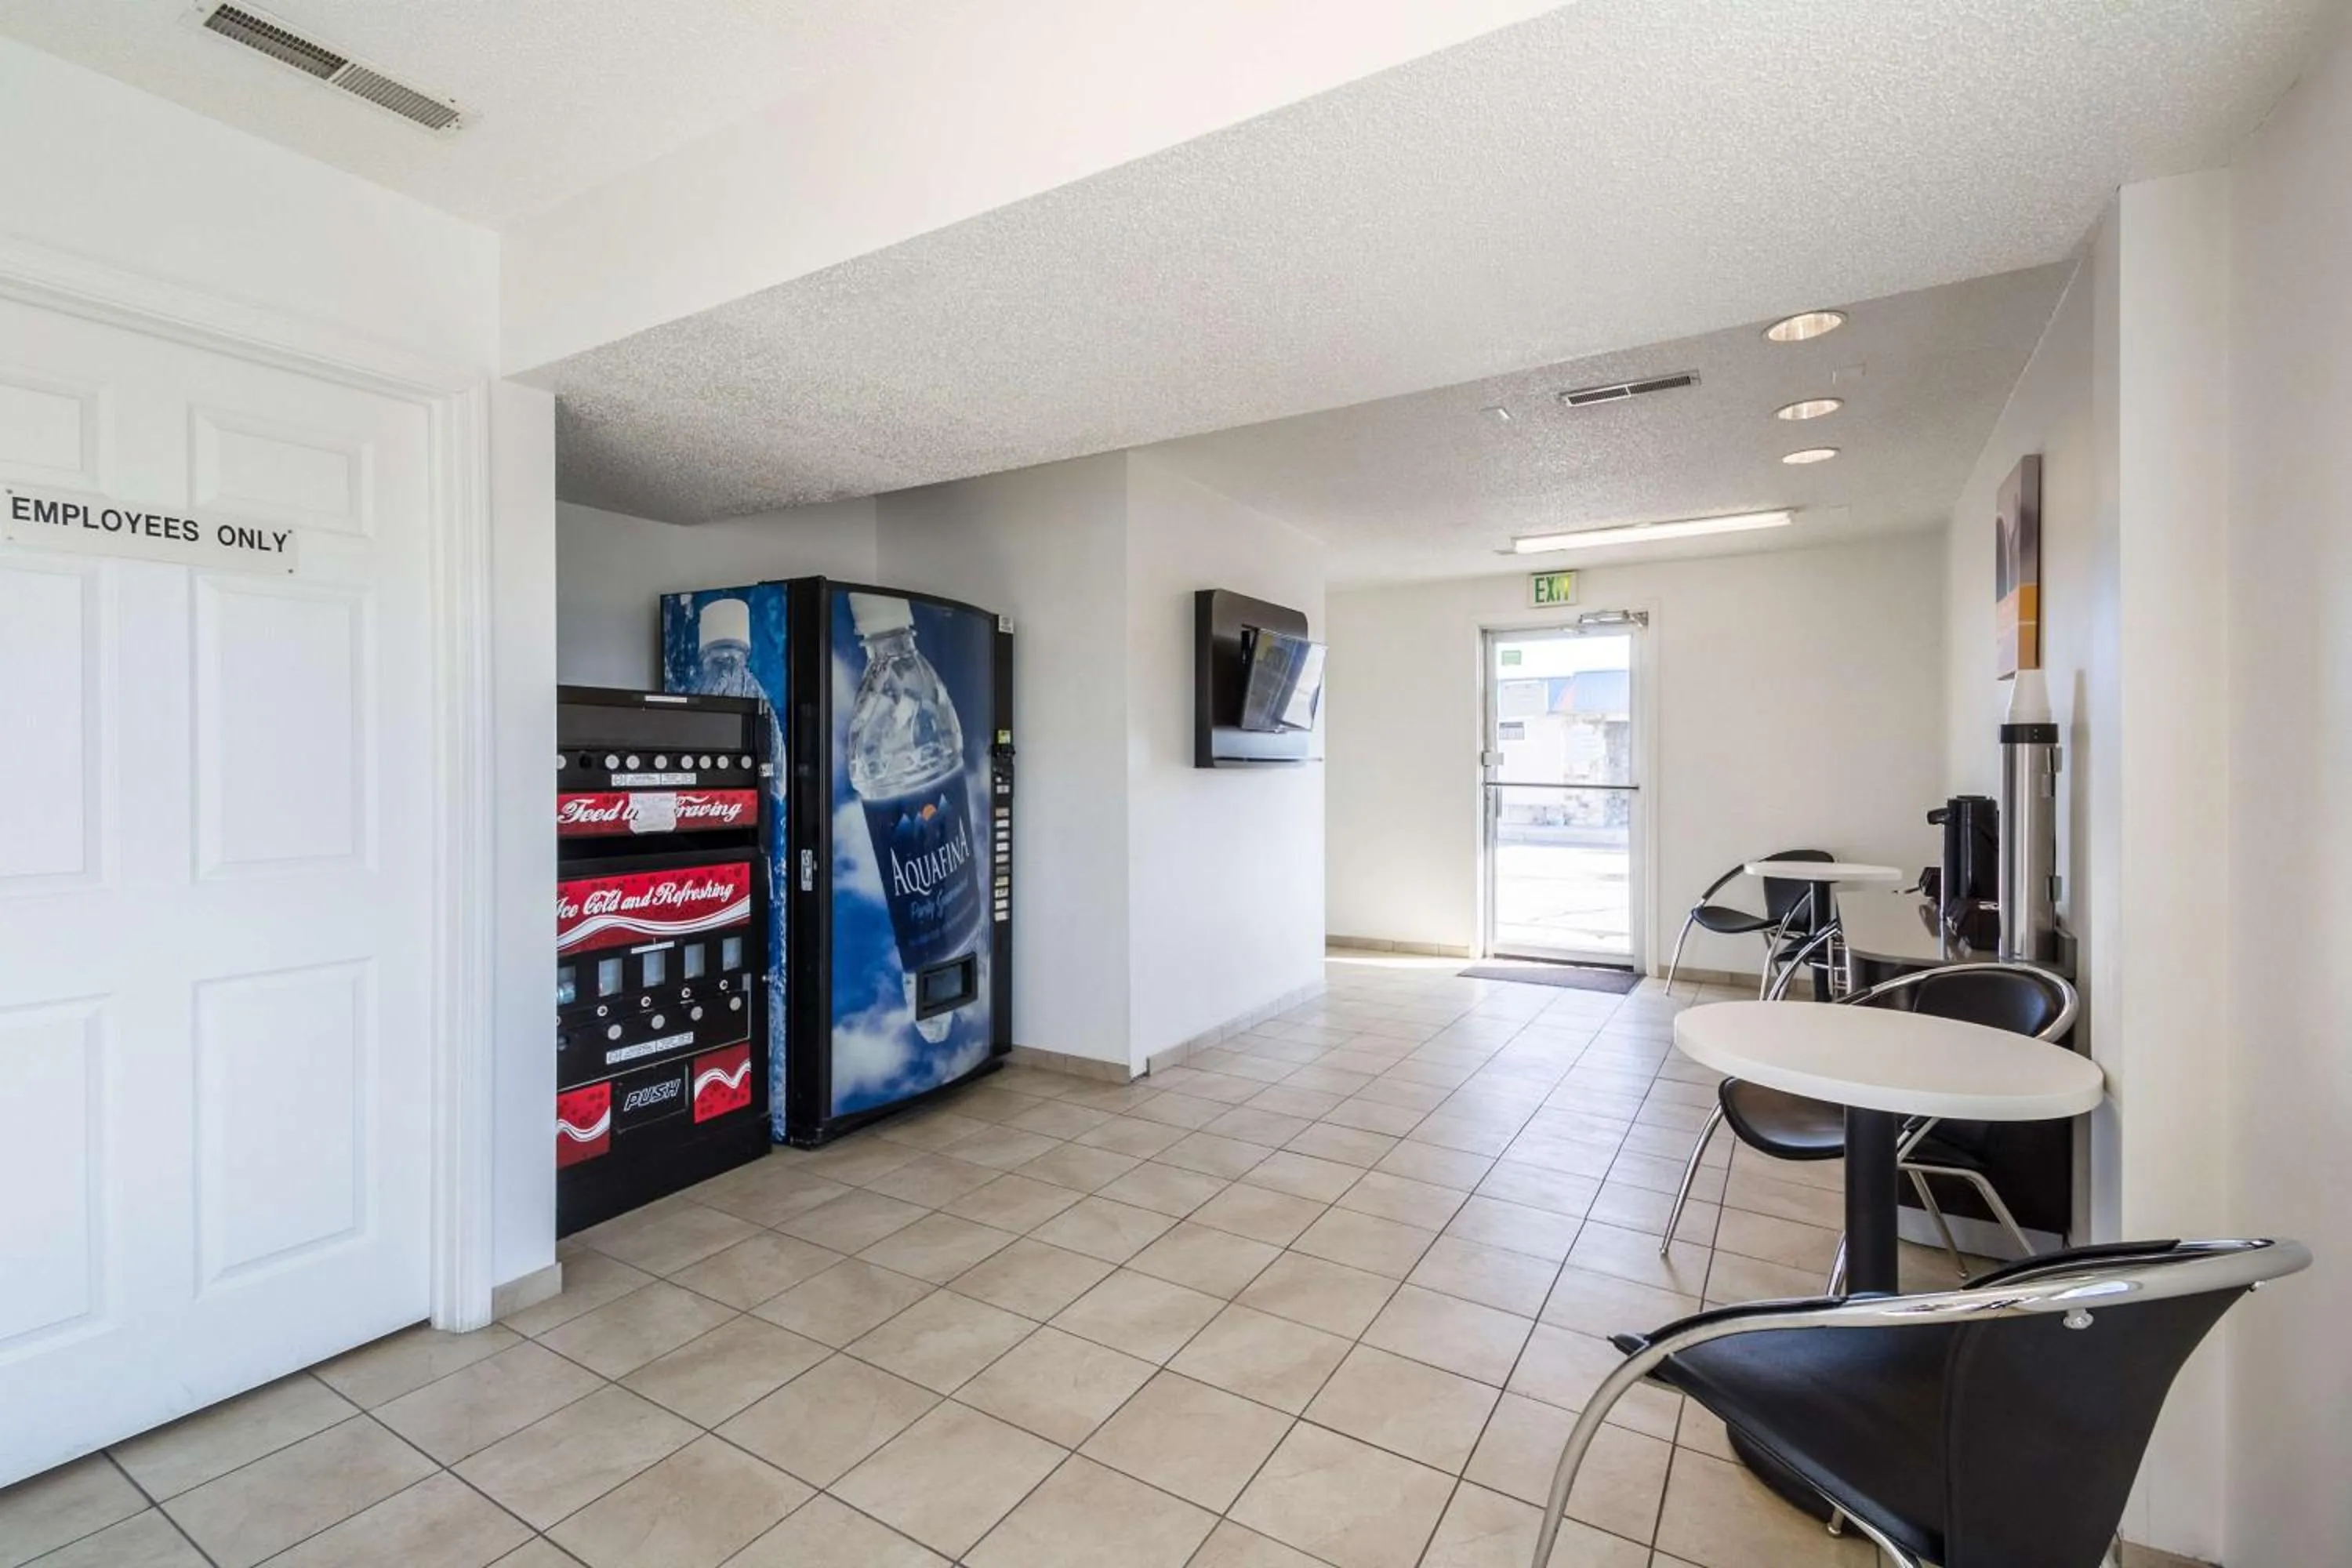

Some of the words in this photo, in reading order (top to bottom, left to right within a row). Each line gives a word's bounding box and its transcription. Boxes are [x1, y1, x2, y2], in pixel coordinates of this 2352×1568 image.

[12, 496, 199, 542] EMPLOYEES
[217, 524, 288, 553] ONLY
[1534, 574, 1572, 603] EXIT
[557, 797, 624, 823] Feed
[890, 815, 970, 896] AQUAFINA
[583, 887, 622, 915] Cold
[620, 885, 654, 910] and
[652, 879, 735, 907] Refreshing
[623, 1078, 681, 1112] PUSH
